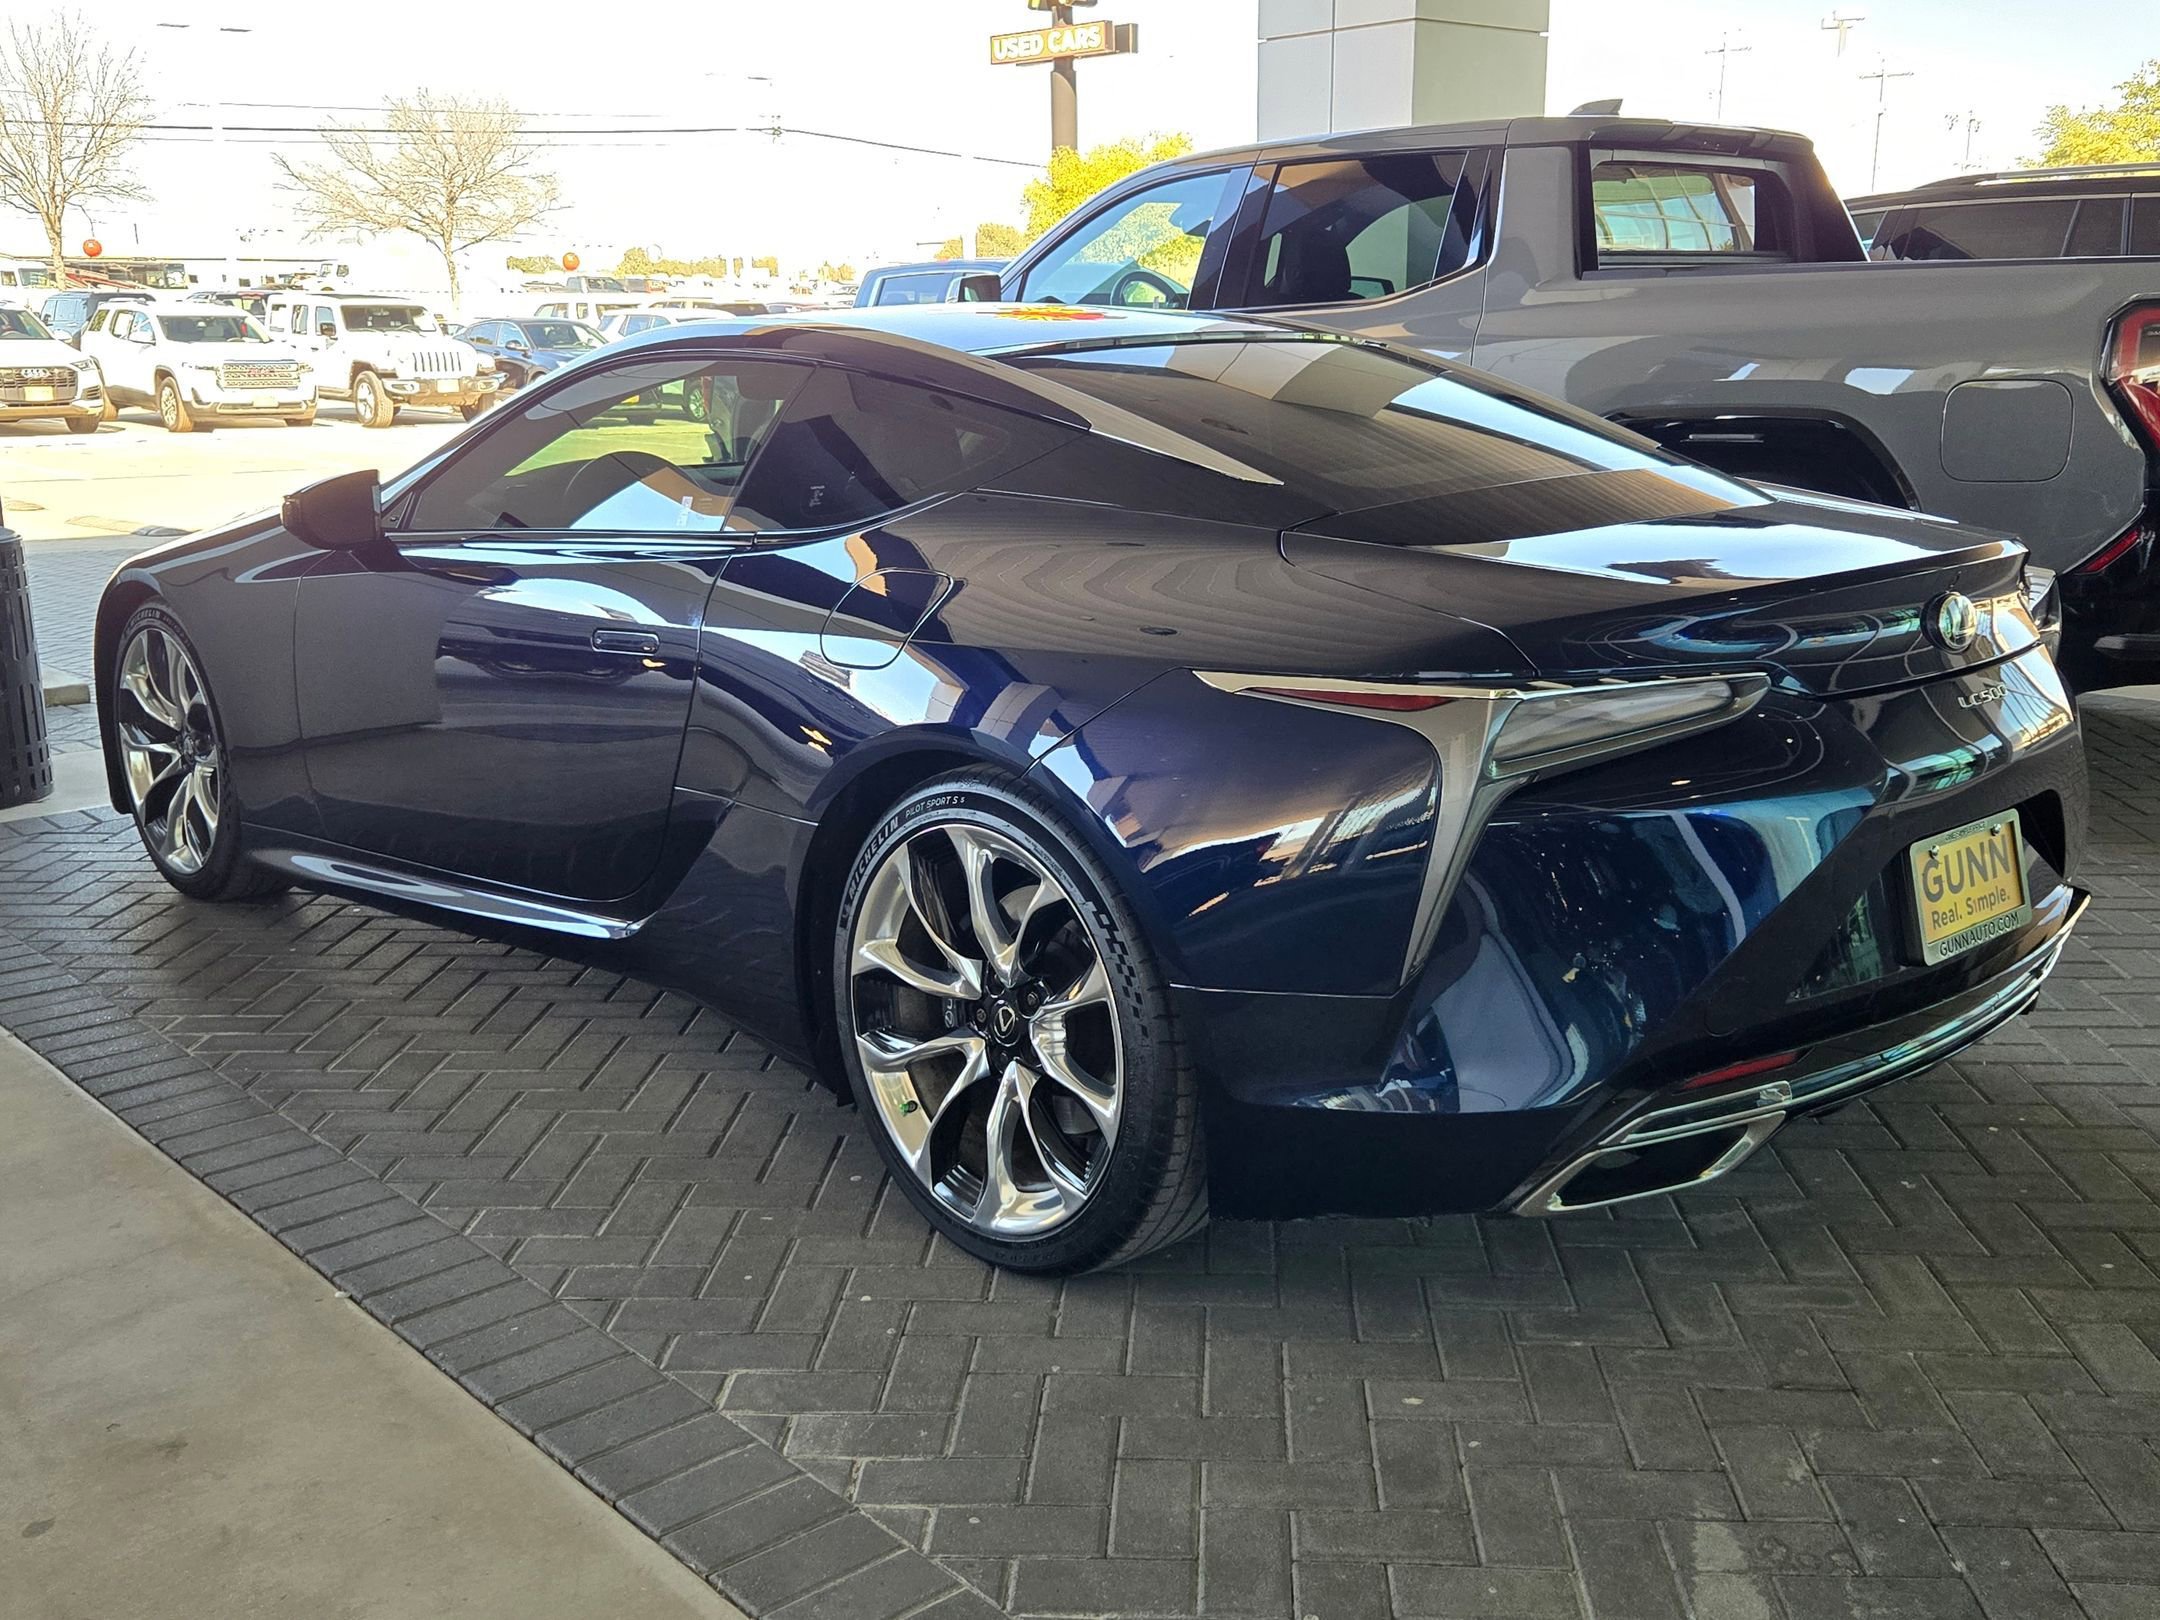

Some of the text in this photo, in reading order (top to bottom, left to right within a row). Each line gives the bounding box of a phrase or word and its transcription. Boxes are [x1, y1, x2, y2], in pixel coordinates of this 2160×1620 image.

[993, 26, 1101, 60] USED CARS
[1958, 684, 2008, 708] LC500
[849, 816, 900, 900] MICHELIN
[905, 801, 926, 819] PILOT
[926, 796, 952, 809] SPORT
[952, 796, 959, 804] S
[1922, 834, 2011, 903] GUNN
[1931, 885, 2010, 930] Real. Simple.
[1939, 911, 2020, 957] GUNNAUTO.COM
